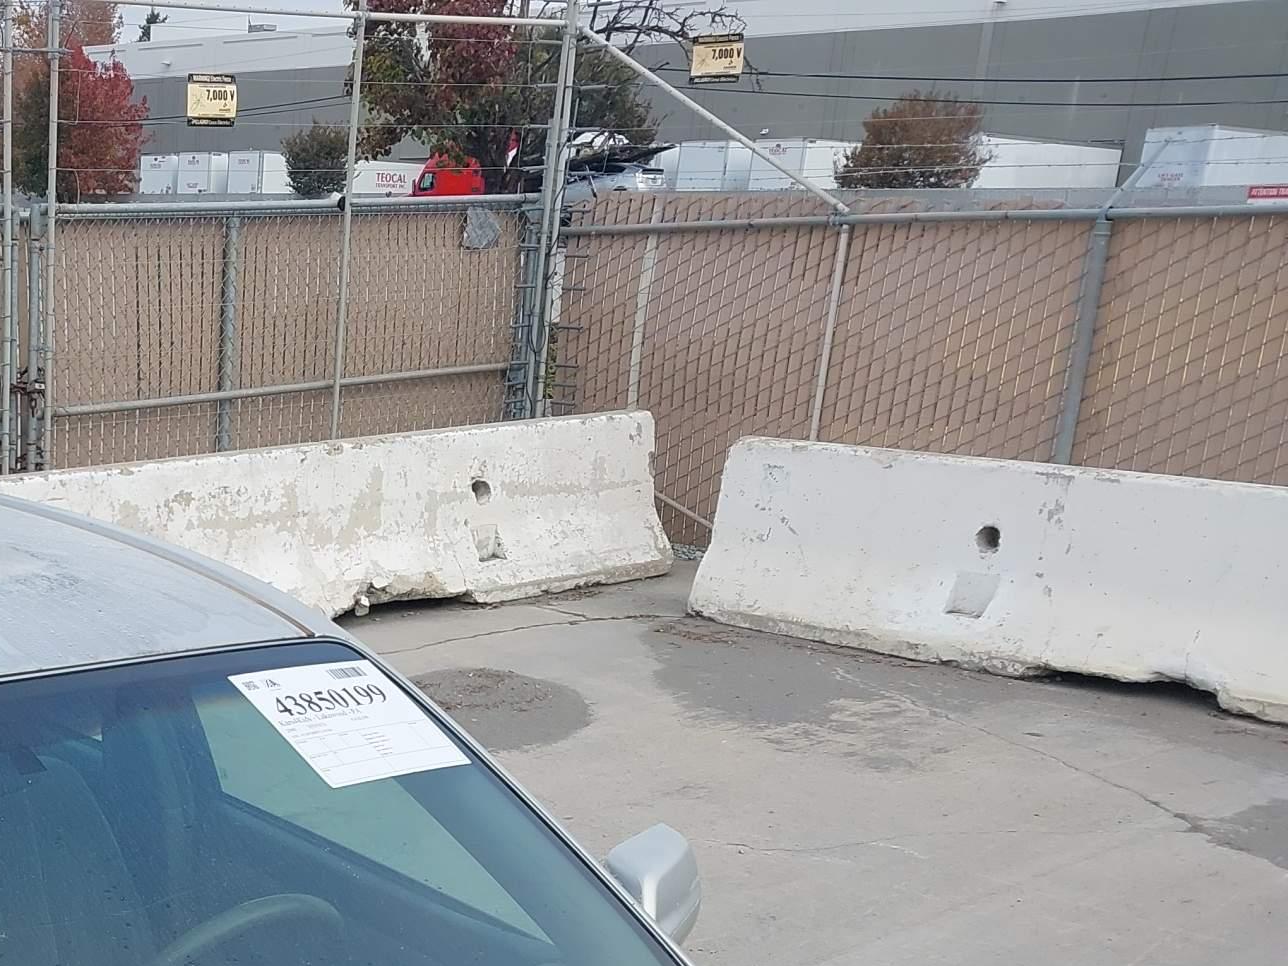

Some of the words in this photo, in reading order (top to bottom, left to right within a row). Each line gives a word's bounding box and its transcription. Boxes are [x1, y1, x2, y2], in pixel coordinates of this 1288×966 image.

[711, 48, 734, 61] 7,000
[736, 48, 742, 58] V
[206, 89, 228, 102] 7,000
[229, 89, 235, 101] V
[376, 172, 407, 184] TEOCAL
[275, 684, 387, 717] 43850199
